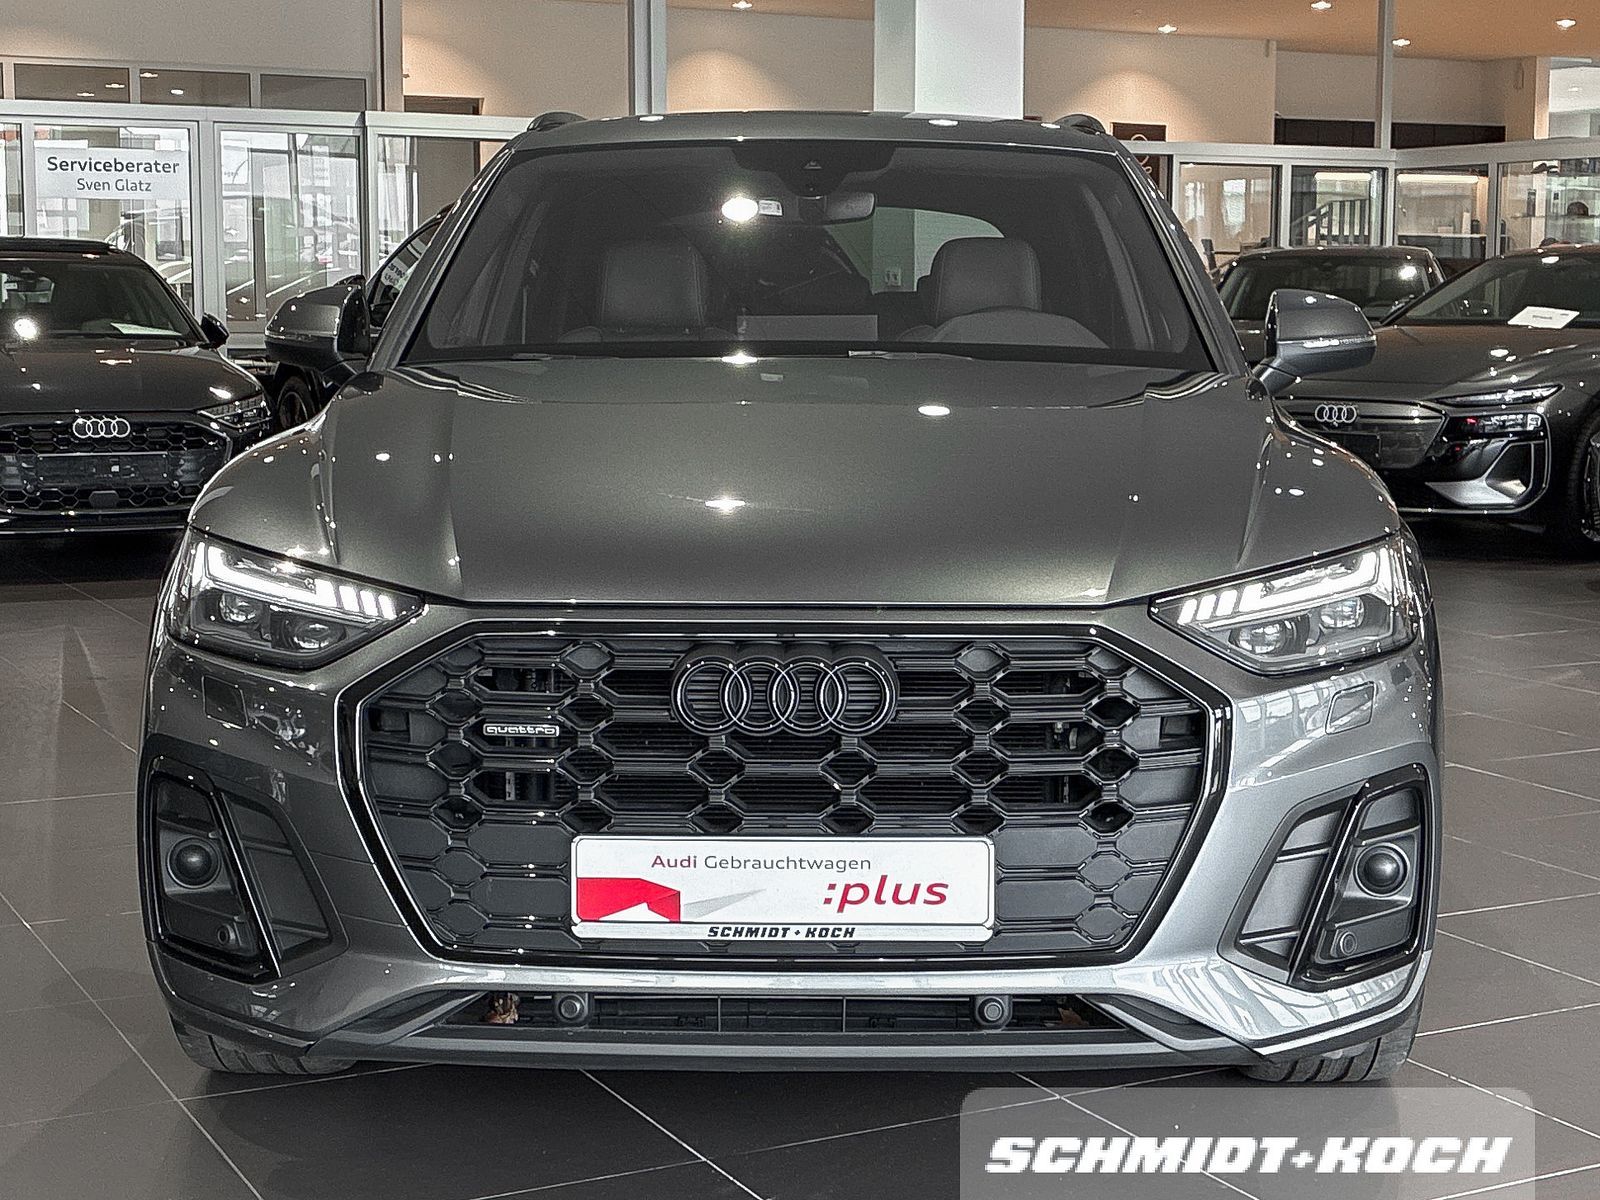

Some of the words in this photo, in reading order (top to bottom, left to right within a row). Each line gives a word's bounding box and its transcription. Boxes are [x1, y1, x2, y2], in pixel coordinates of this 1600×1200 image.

[46, 156, 180, 173] Serviceberater
[76, 177, 111, 191] Sven
[114, 178, 152, 192] Glatz
[486, 725, 556, 734] quattro
[651, 854, 698, 869] Audi
[704, 855, 872, 872] Gebrauchtwagen
[707, 926, 790, 938] SCHMIDT
[804, 926, 856, 938] KOCH
